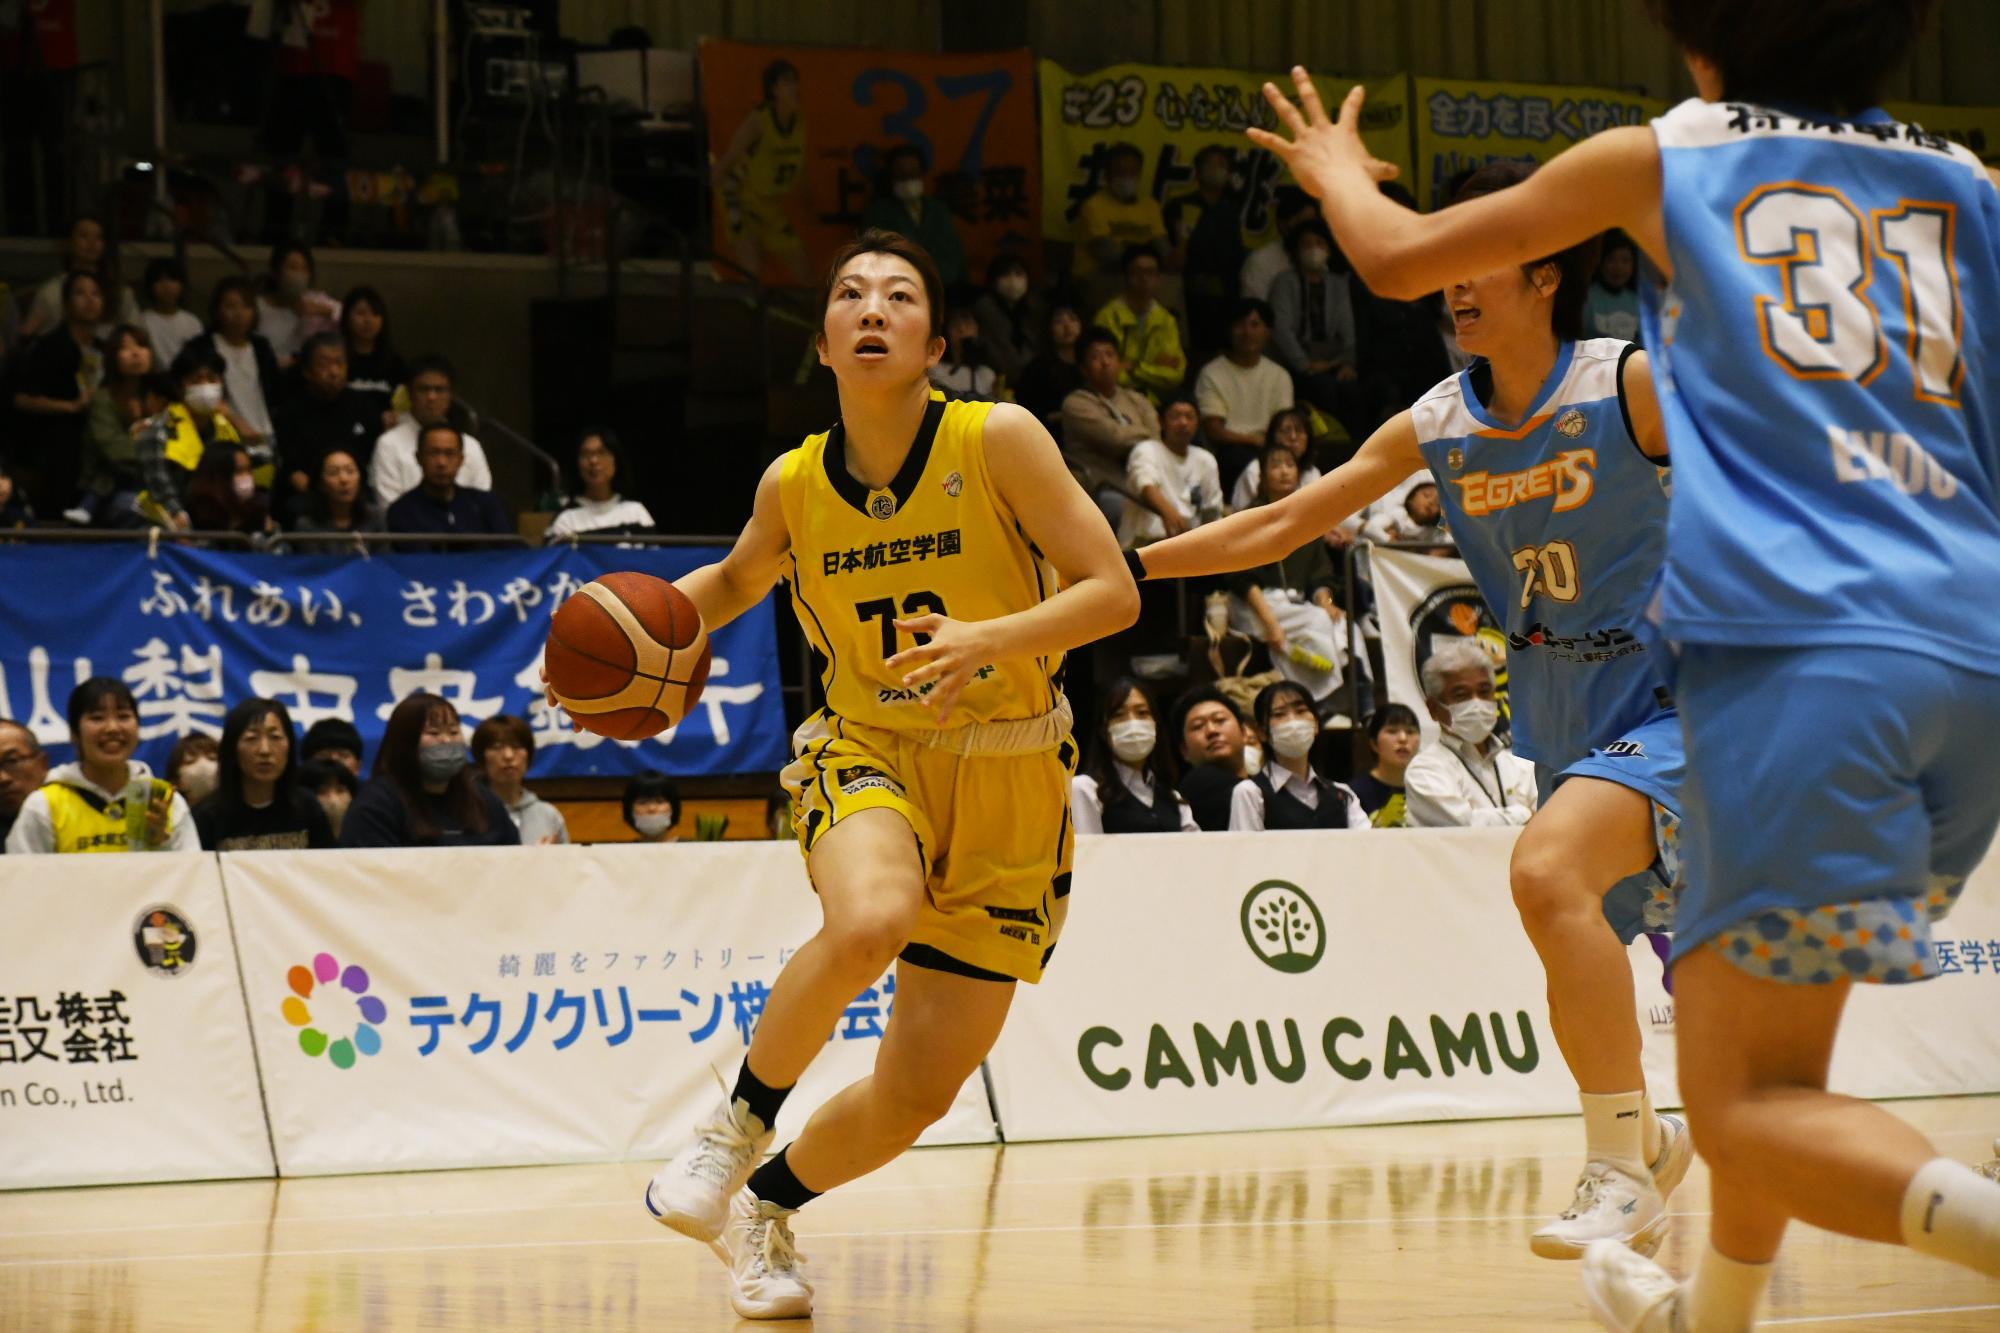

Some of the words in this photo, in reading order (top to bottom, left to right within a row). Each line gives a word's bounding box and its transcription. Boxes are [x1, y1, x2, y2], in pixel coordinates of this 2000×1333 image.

[1734, 179, 1964, 409] 31
[1450, 448, 1597, 516] EGRETS
[823, 528, 961, 577] 日本航空学園
[1077, 1017, 1306, 1091] CAMU
[1322, 1009, 1540, 1081] CAMU
[24, 1082, 77, 1109] Co.,
[83, 1077, 134, 1105] Ltd.
